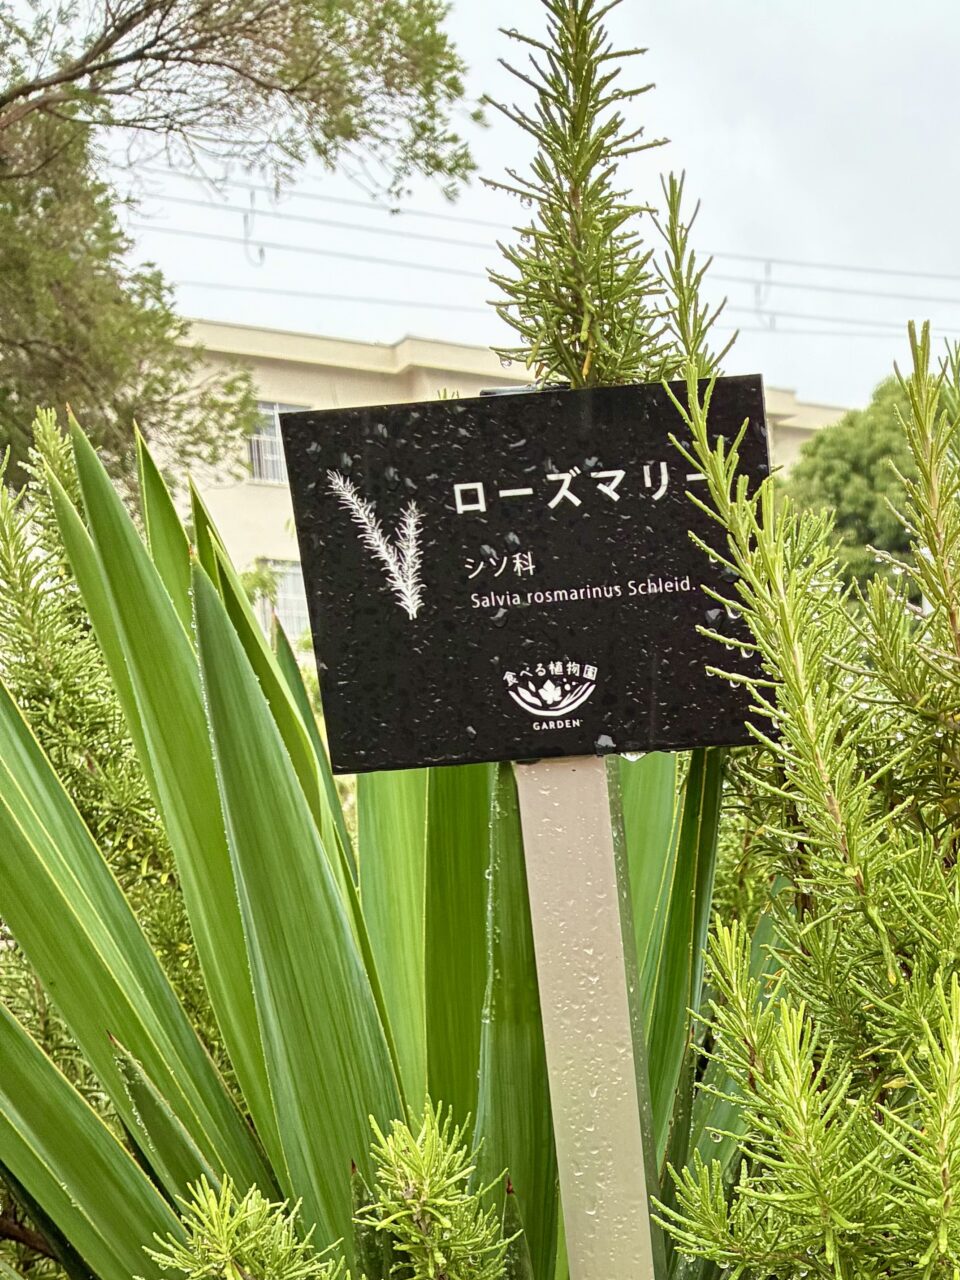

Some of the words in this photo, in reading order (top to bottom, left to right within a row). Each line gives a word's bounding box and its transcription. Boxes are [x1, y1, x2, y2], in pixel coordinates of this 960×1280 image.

[453, 461, 708, 514] ローズマリー
[464, 551, 535, 579] シソ科
[470, 590, 521, 609] Salvia
[527, 584, 622, 604] rosmarinus
[628, 575, 697, 596] Schleid.
[532, 719, 580, 731] GARDEN
